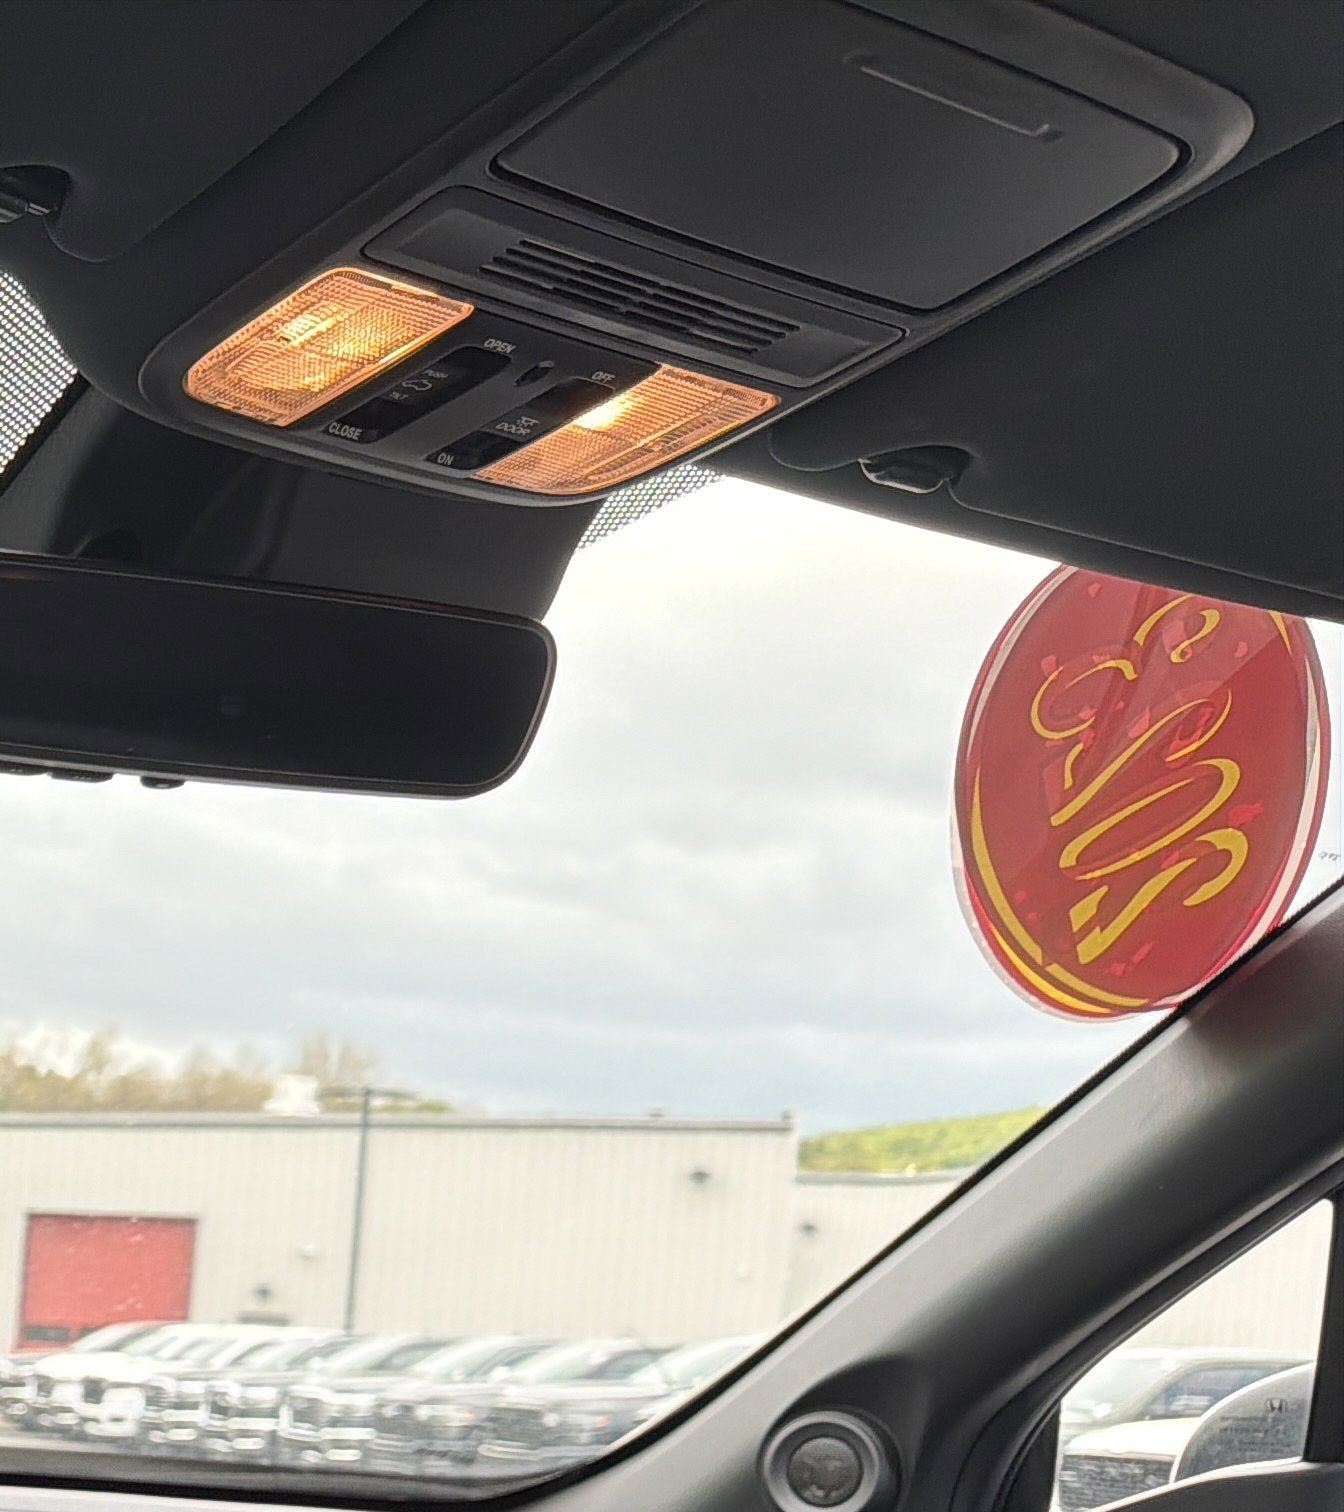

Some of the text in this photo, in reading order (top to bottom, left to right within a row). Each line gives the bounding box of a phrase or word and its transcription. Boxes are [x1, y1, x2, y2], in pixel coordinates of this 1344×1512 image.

[483, 338, 516, 354] OPEN
[592, 371, 616, 383] OFF
[328, 421, 362, 441] CLOSE
[495, 421, 531, 436] DOOR
[436, 452, 454, 466] ON
